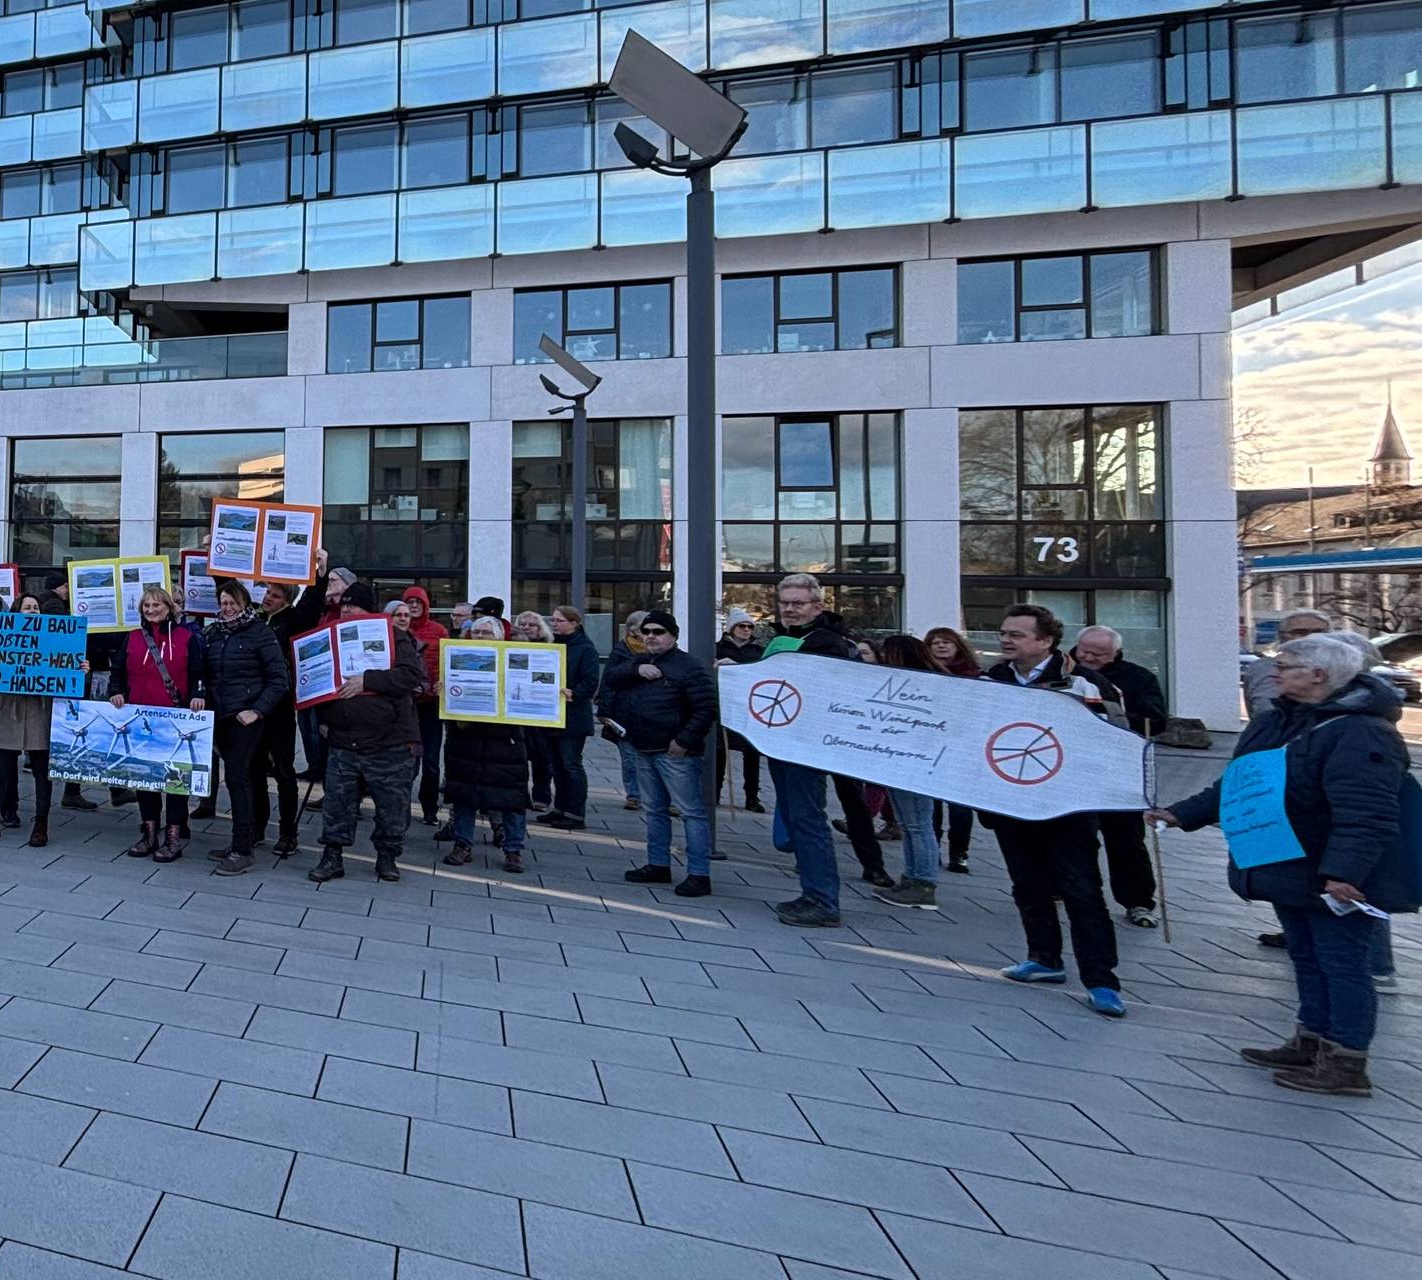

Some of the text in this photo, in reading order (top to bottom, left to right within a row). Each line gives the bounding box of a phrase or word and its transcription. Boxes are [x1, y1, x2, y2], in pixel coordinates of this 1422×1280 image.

[1033, 537, 1079, 563] 73
[21, 616, 42, 632] ZU
[47, 618, 85, 634] BAU-
[15, 666, 26, 675] IN
[872, 674, 933, 702] Nein
[134, 708, 207, 722] Artenschutz Ade
[870, 708, 947, 732] Windpark
[856, 723, 909, 735] an der
[49, 769, 62, 778] Ein
[62, 771, 82, 780] Dorf
[81, 773, 100, 782] wird
[101, 775, 126, 785] weiter
